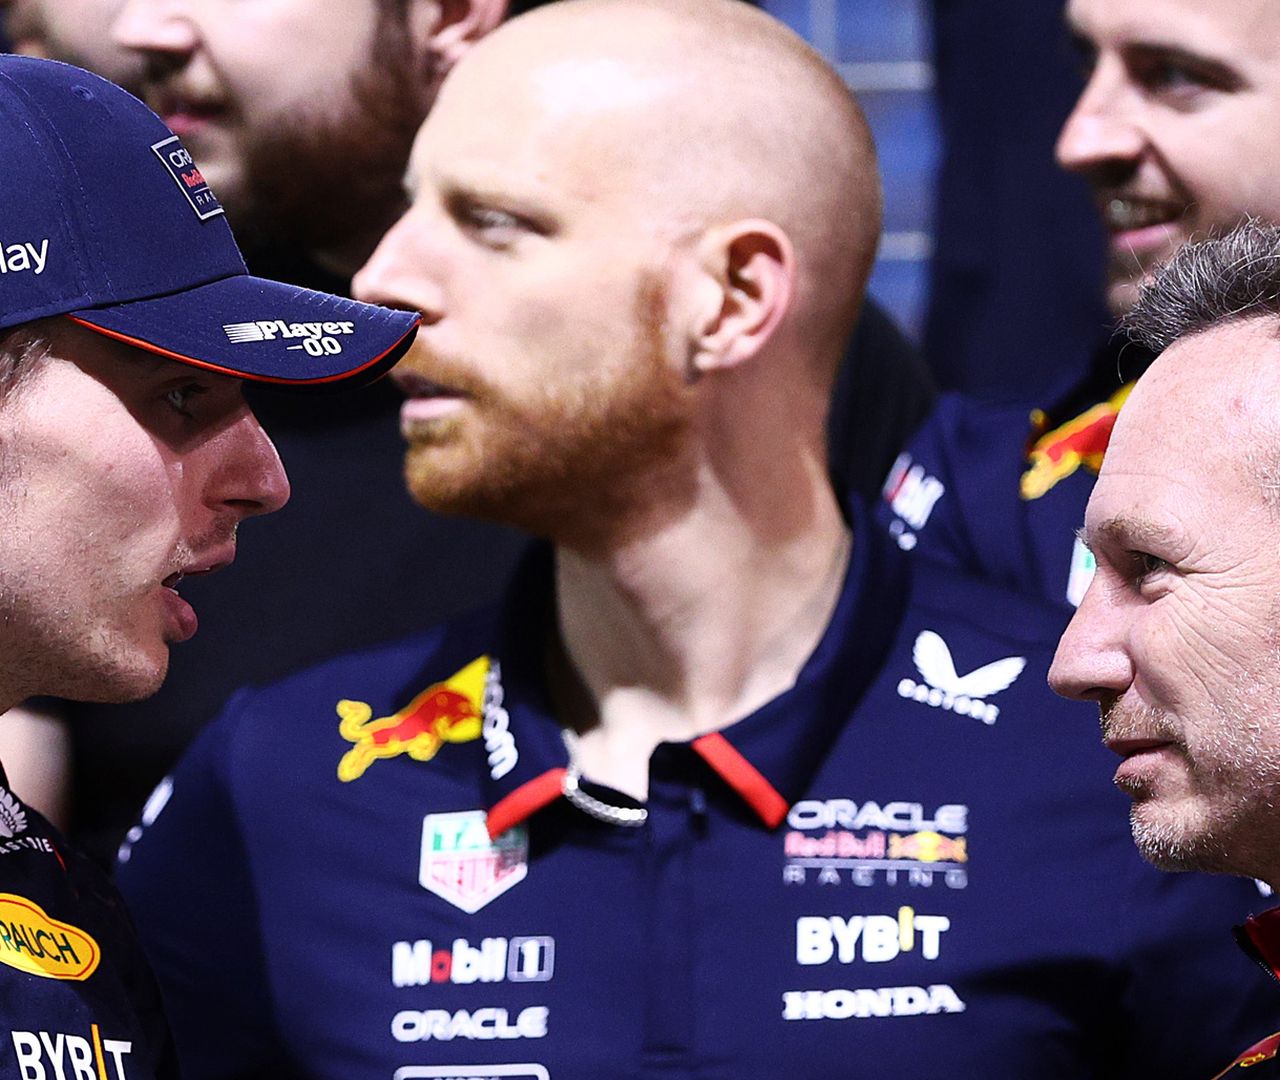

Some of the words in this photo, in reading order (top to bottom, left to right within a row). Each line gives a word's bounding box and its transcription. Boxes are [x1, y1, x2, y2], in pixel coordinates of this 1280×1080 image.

[256, 320, 354, 341] Player
[787, 799, 969, 834] ORACLE
[796, 906, 950, 965] BYBIT
[392, 938, 508, 987] Mobil
[782, 984, 966, 1020] HONDA
[391, 1006, 549, 1042] ORACLE
